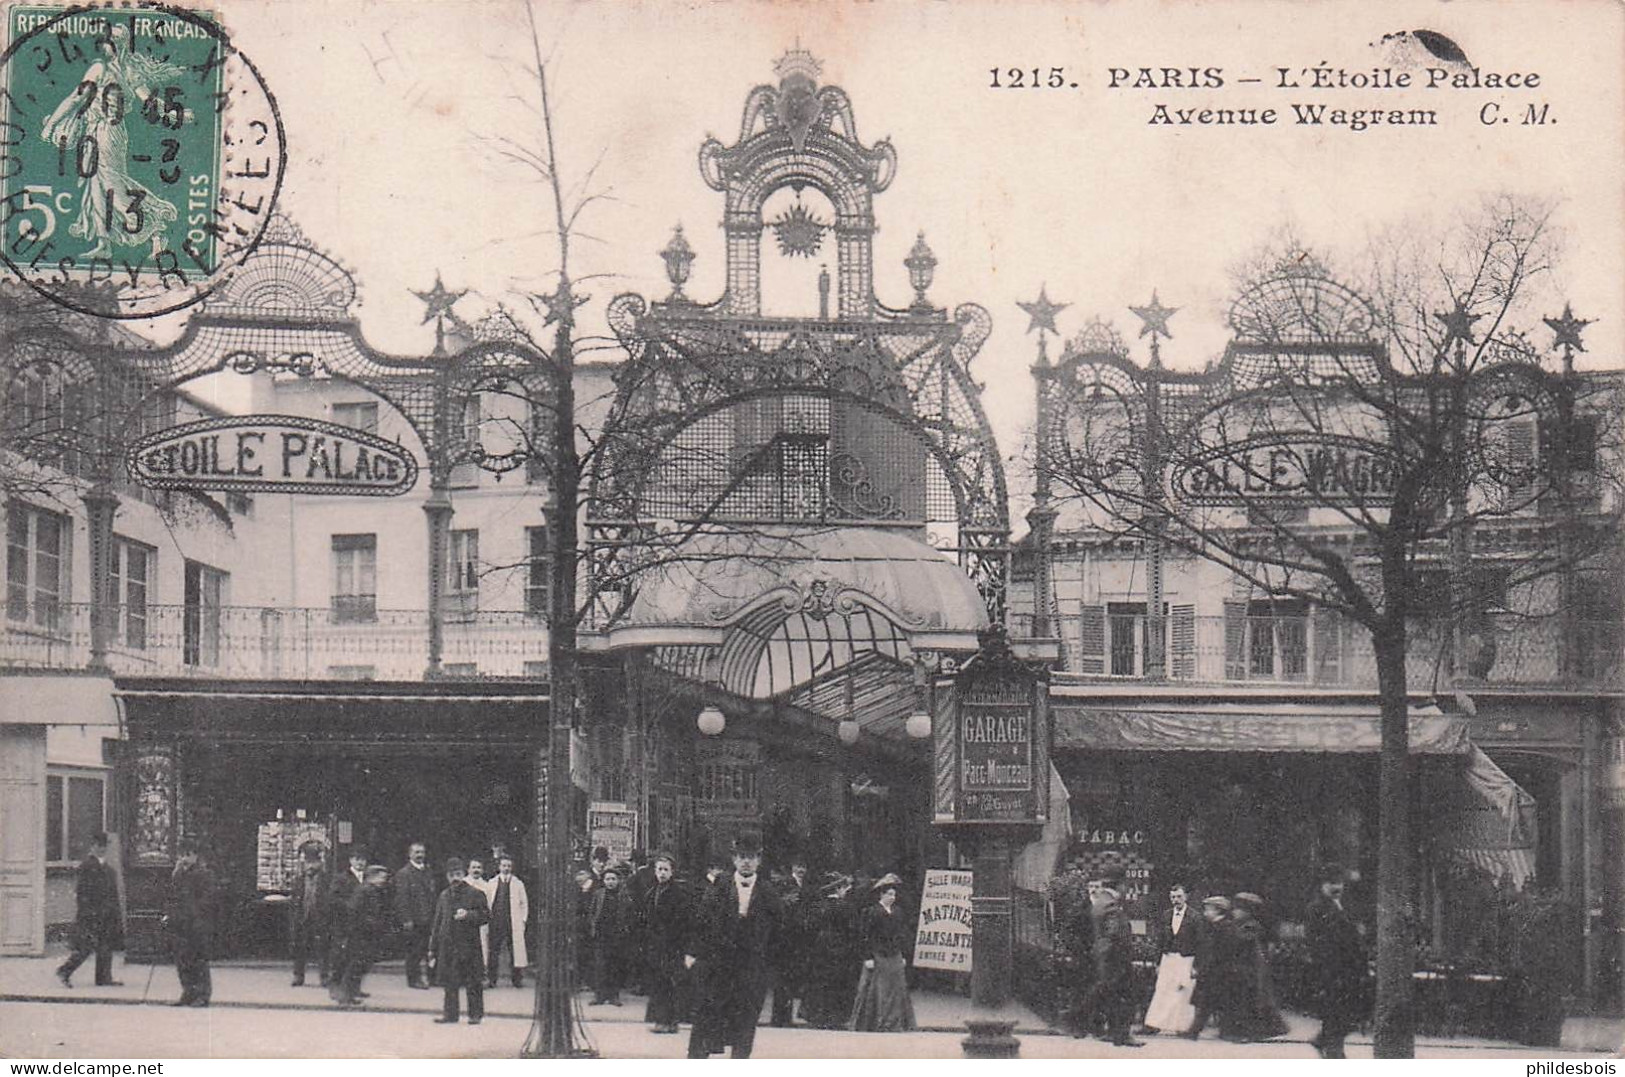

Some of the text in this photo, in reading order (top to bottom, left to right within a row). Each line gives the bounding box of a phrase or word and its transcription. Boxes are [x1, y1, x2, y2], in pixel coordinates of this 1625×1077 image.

[990, 67, 1078, 88] 1215.
[1108, 67, 1224, 88] PARIS
[1277, 60, 1411, 88] L'Étoile
[1426, 67, 1540, 89] Palace
[1148, 102, 1557, 131] Avenue Wagram C. M.
[187, 173, 209, 246] POSTES
[281, 432, 399, 481] PALACE
[964, 716, 1027, 744] GARAGE
[1078, 829, 1145, 844] TABAC
